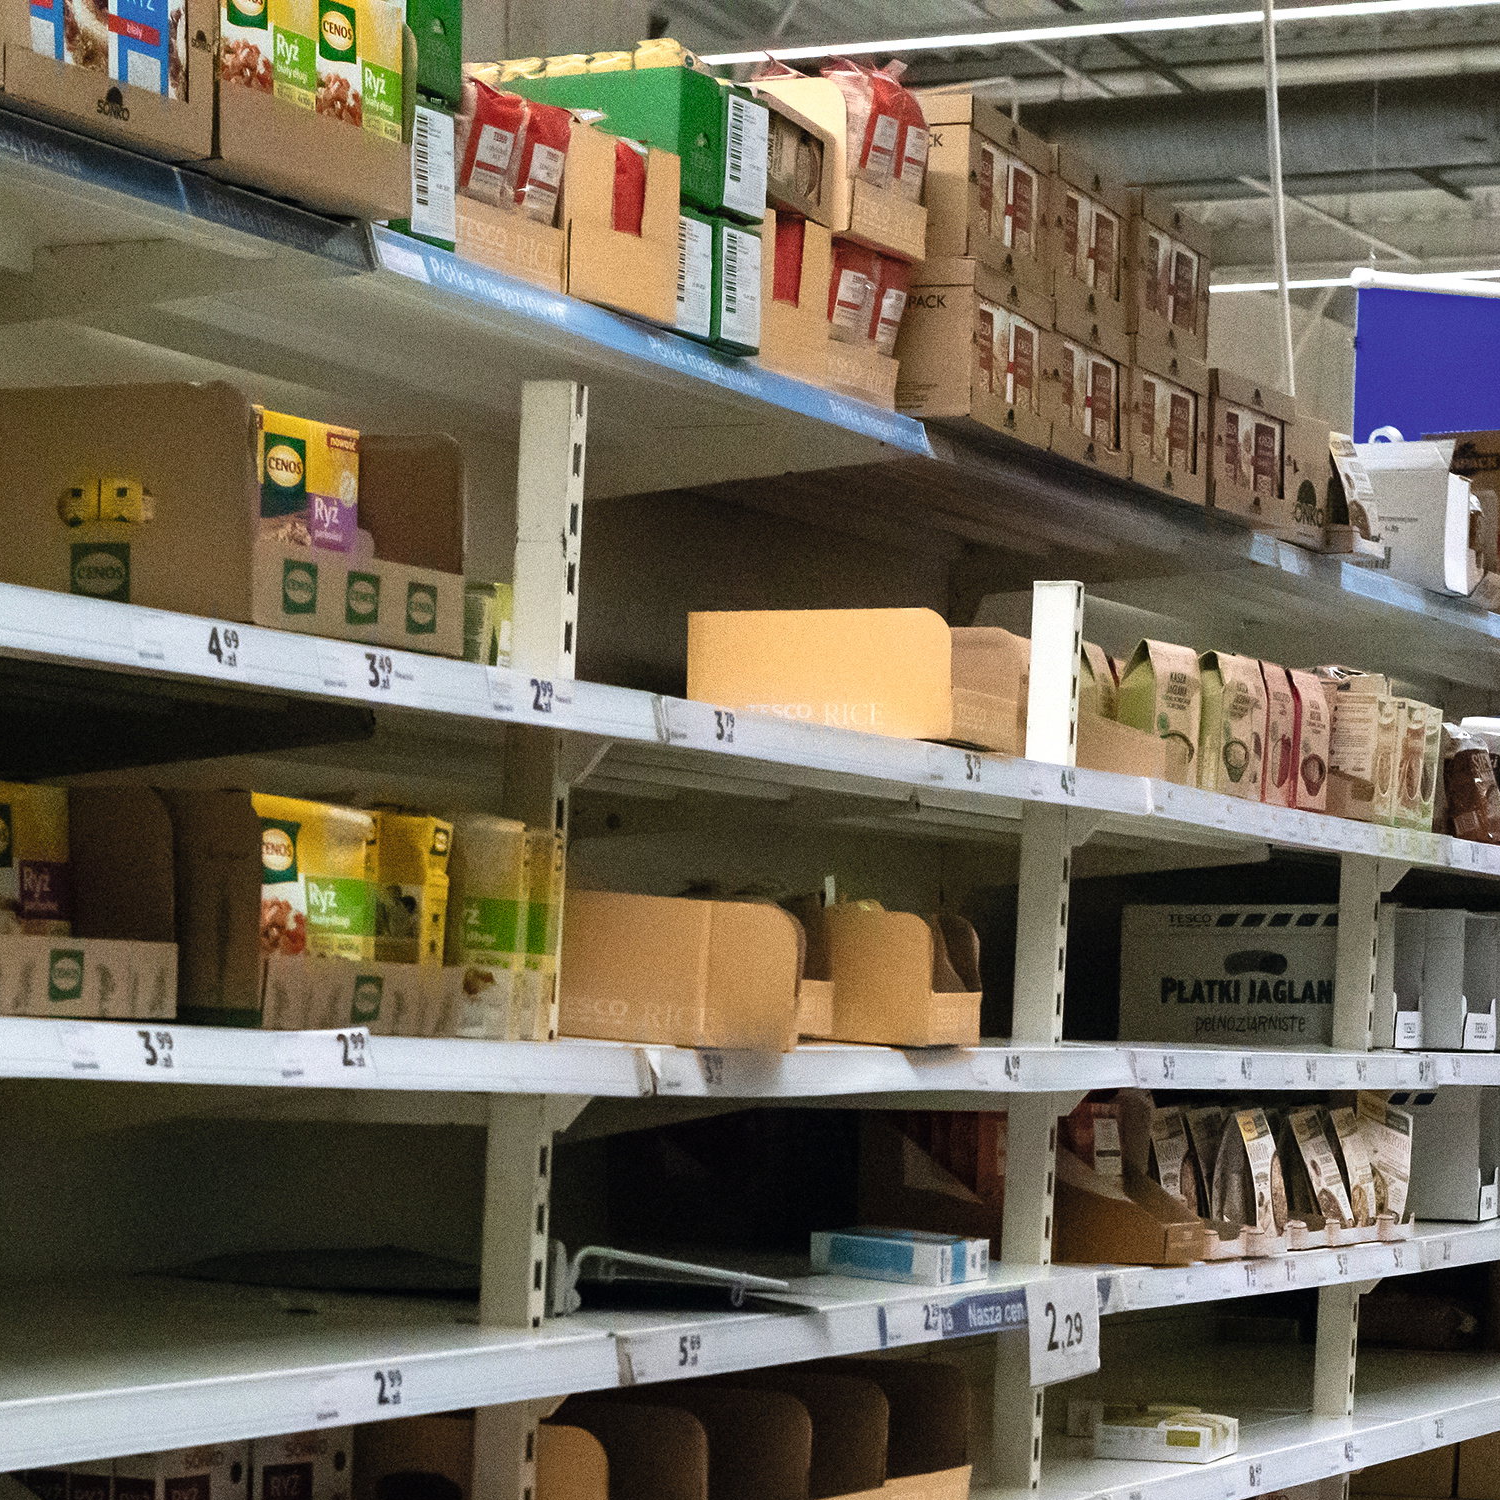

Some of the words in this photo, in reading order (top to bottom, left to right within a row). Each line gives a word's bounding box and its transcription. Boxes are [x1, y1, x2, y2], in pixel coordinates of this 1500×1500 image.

[322, 18, 354, 44] CENOS
[275, 32, 300, 63] Ryż
[363, 66, 389, 97] Ryż
[268, 456, 302, 474] CENOS
[314, 497, 340, 528] Ryż
[307, 882, 338, 910] Ryż
[1168, 914, 1213, 925] TESCO
[1161, 977, 1240, 1004] PŁATKI
[1243, 978, 1333, 1005] JAGLAN
[968, 1304, 1003, 1328] Nasza
[1043, 1300, 1084, 1353] 2,29
